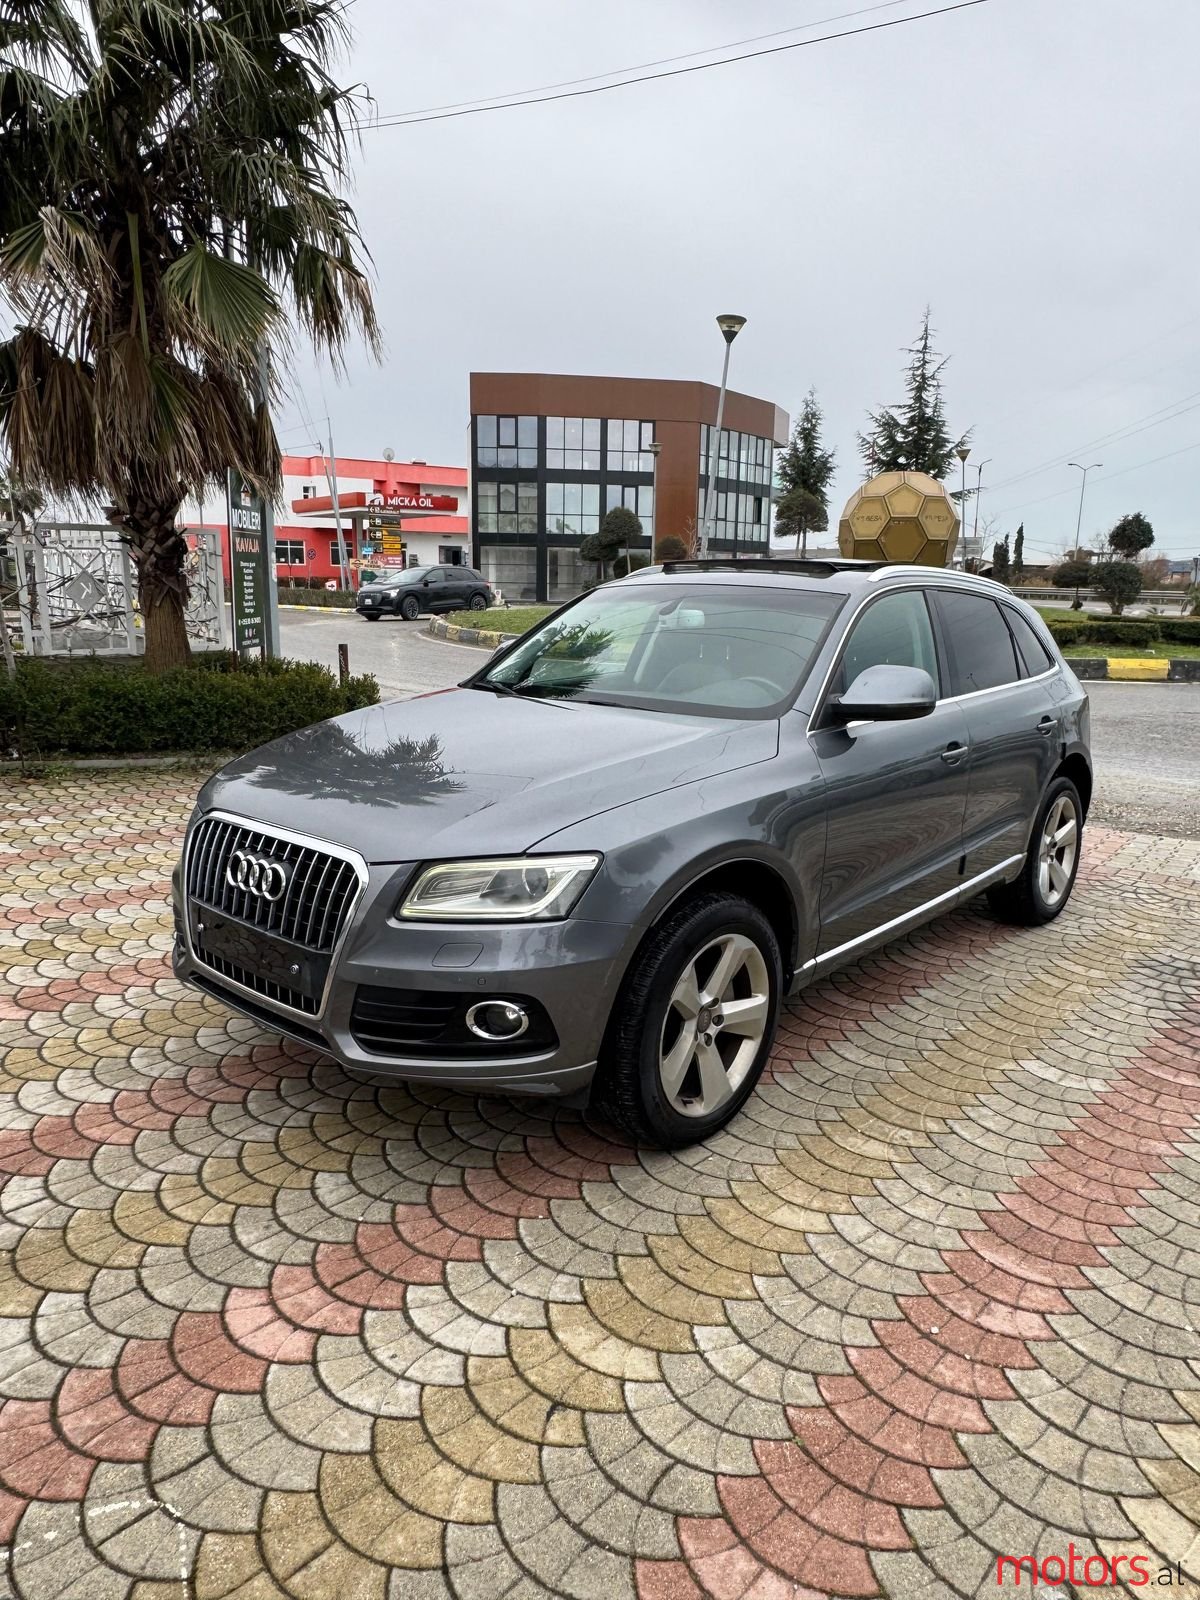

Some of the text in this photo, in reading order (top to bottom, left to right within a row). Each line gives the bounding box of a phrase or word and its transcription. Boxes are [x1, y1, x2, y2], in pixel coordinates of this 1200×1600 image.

[388, 497, 434, 508] MICKA OIL
[236, 537, 260, 553] KAVAJA
